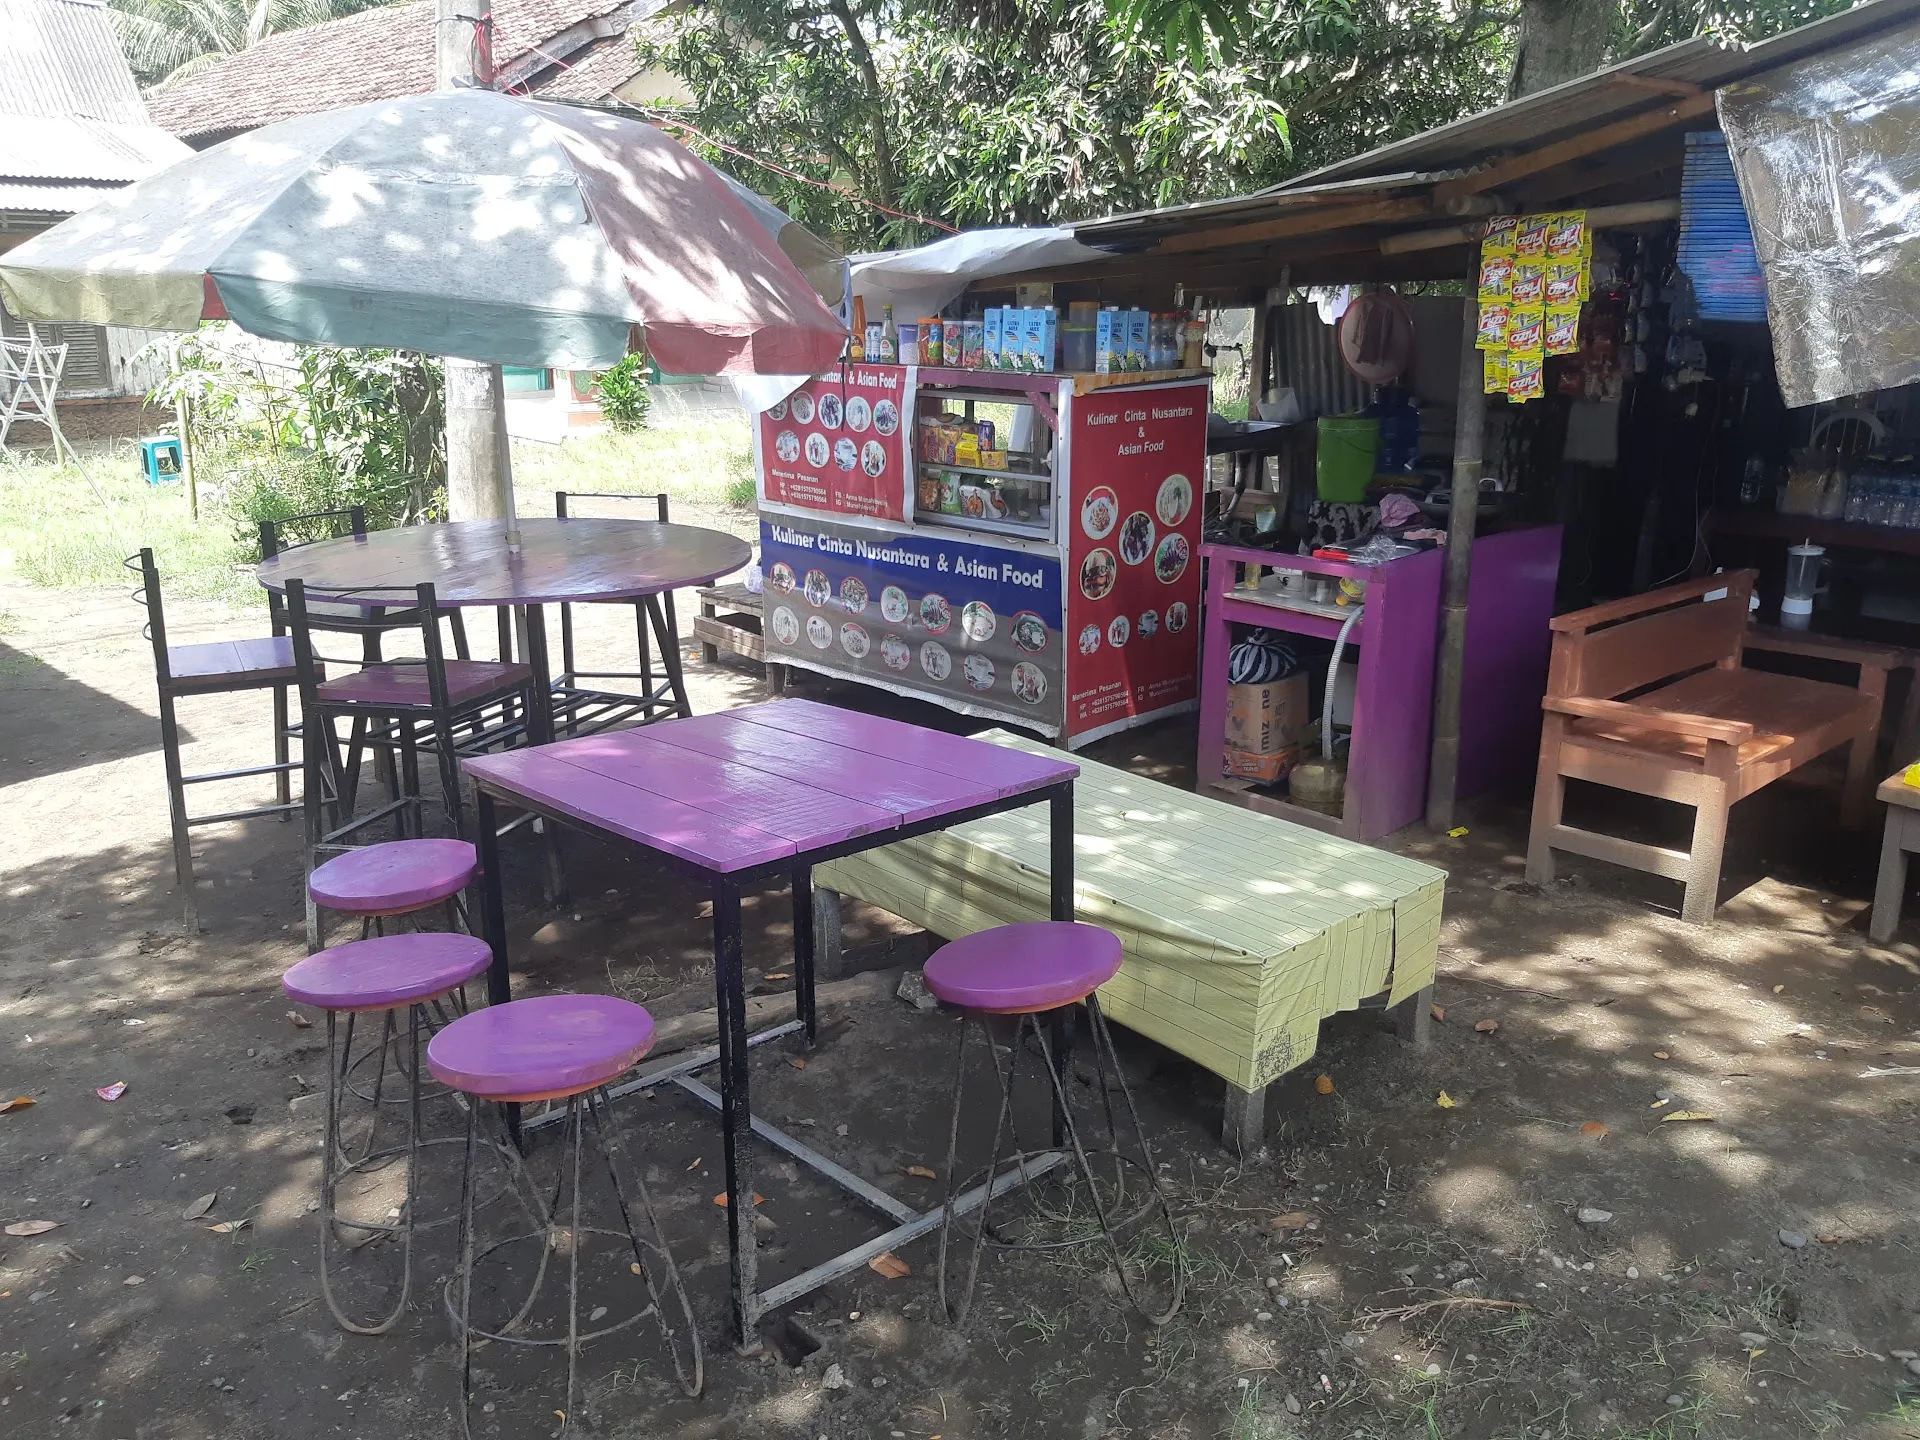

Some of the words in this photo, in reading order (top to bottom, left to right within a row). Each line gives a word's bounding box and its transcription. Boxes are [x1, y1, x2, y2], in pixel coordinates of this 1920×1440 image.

[848, 370, 855, 385] &
[857, 370, 878, 387] Asian
[878, 372, 898, 390] Food
[1087, 413, 1118, 426] Kuliner
[1124, 410, 1146, 422] Cinta
[1152, 407, 1193, 419] Nusantara
[1137, 426, 1145, 438] &
[1117, 443, 1142, 456] Asian
[1143, 439, 1164, 453] Food
[771, 524, 815, 549] Kuliner
[817, 533, 853, 556] Cinta
[856, 539, 930, 569] Nusantara
[937, 553, 949, 573] &
[954, 555, 998, 581] Asian
[1002, 563, 1043, 589] Food
[1098, 681, 1122, 692] Pesanan
